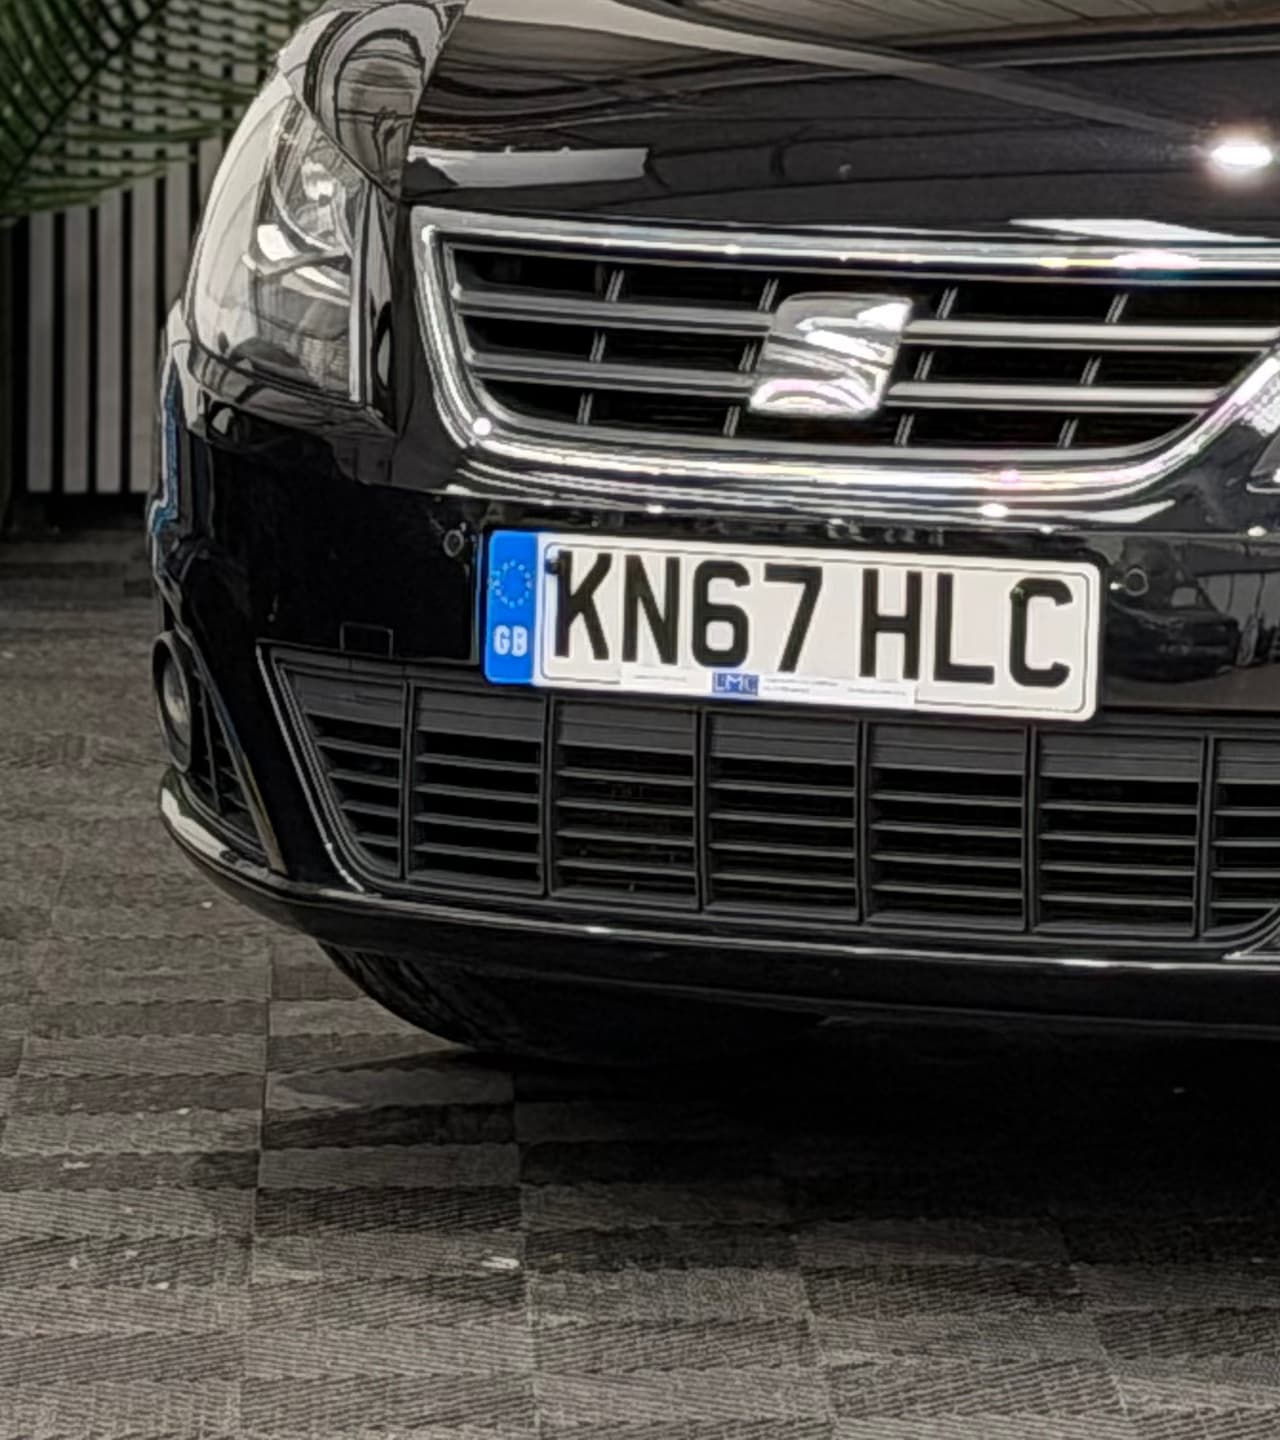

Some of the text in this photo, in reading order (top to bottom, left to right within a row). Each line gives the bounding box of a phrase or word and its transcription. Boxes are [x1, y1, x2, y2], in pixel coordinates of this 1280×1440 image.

[491, 624, 529, 657] GB
[554, 549, 1075, 688] KN67 HLC
